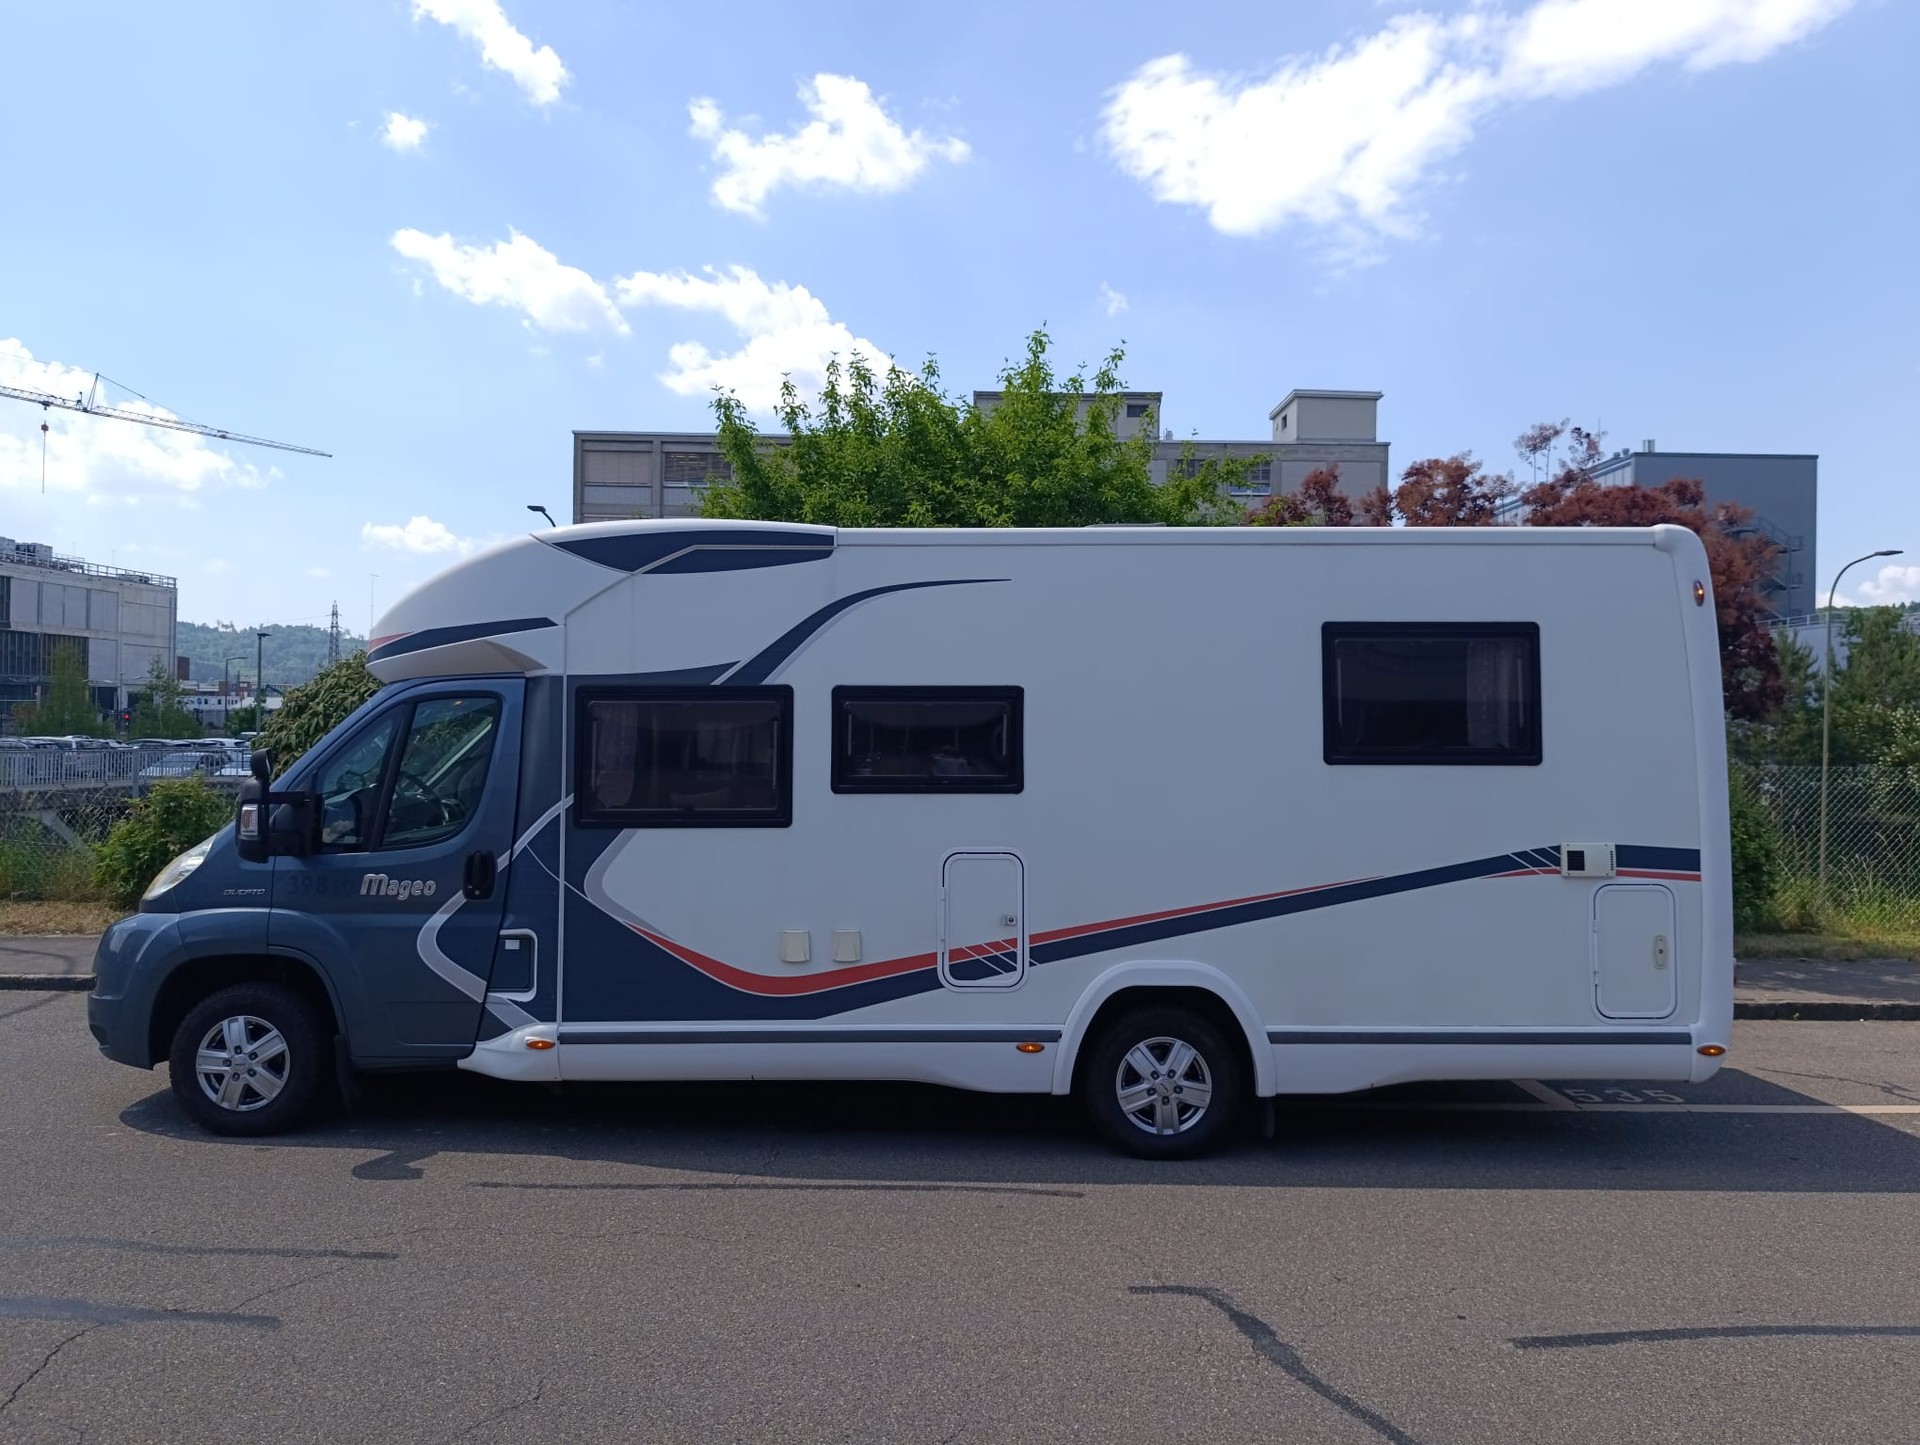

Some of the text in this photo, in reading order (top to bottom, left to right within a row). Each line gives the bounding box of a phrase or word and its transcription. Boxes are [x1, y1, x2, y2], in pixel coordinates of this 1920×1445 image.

[223, 888, 266, 896] DUCATO
[287, 874, 327, 895] 398
[360, 873, 437, 901] Mageo
[1563, 1089, 1686, 1103] 535
